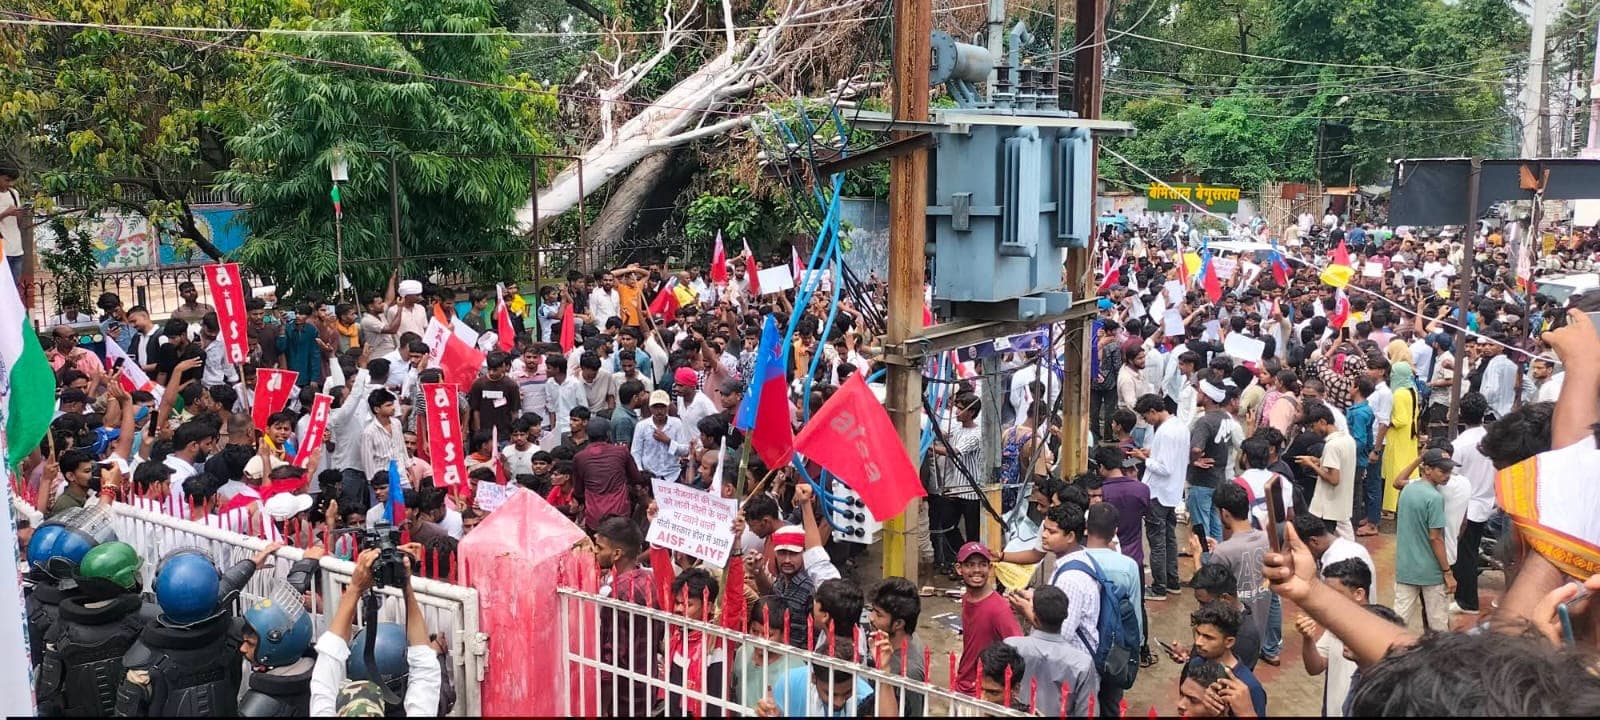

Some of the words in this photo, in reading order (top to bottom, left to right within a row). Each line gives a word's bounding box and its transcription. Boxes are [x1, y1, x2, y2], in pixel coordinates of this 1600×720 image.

[1149, 182, 1191, 200] बेमिसाल
[1195, 183, 1241, 206] बेगूसराय
[215, 267, 243, 362] aisa
[435, 388, 461, 485] aisa
[671, 522, 692, 536] सरकार
[656, 530, 686, 547] AISF
[695, 543, 725, 561] AIYF
